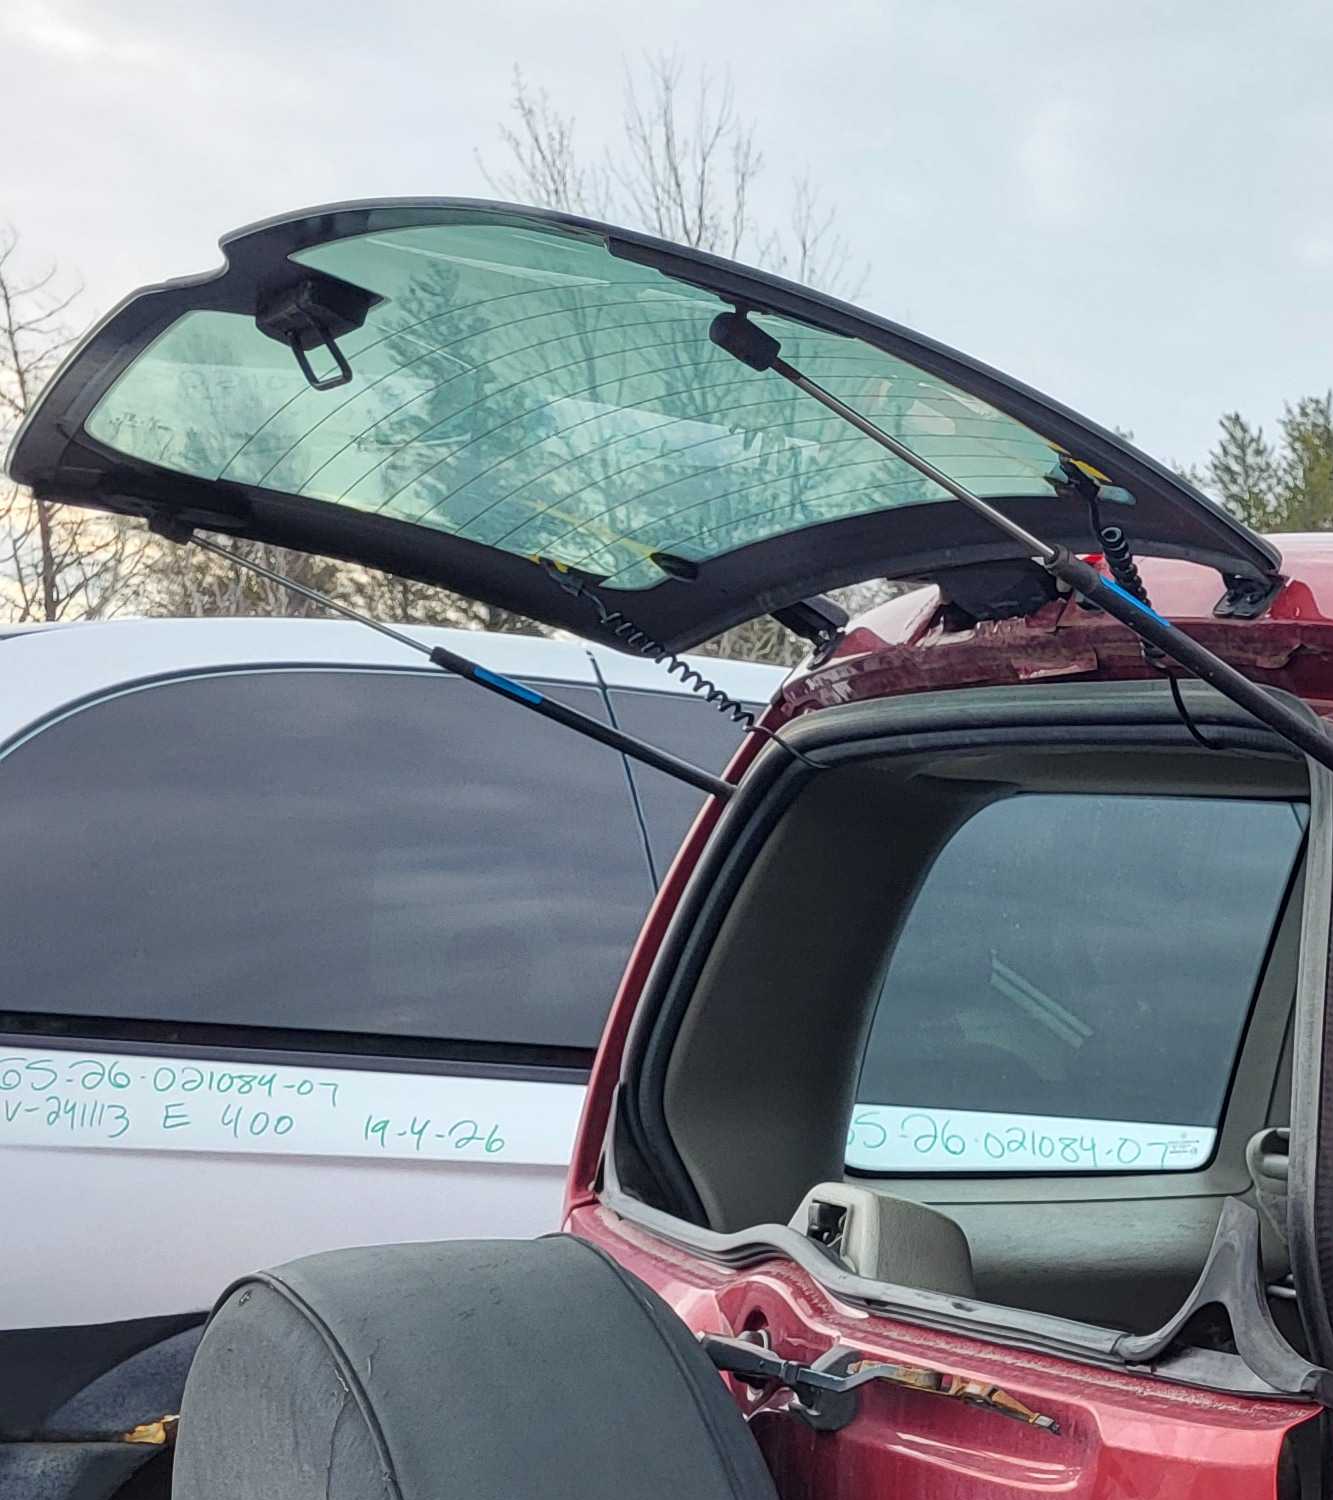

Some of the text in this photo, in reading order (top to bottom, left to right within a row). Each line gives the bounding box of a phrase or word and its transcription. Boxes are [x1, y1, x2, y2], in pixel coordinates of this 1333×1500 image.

[163, 1103, 191, 1130] E
[221, 1104, 295, 1139] 400
[363, 1114, 505, 1153] 19-4-26
